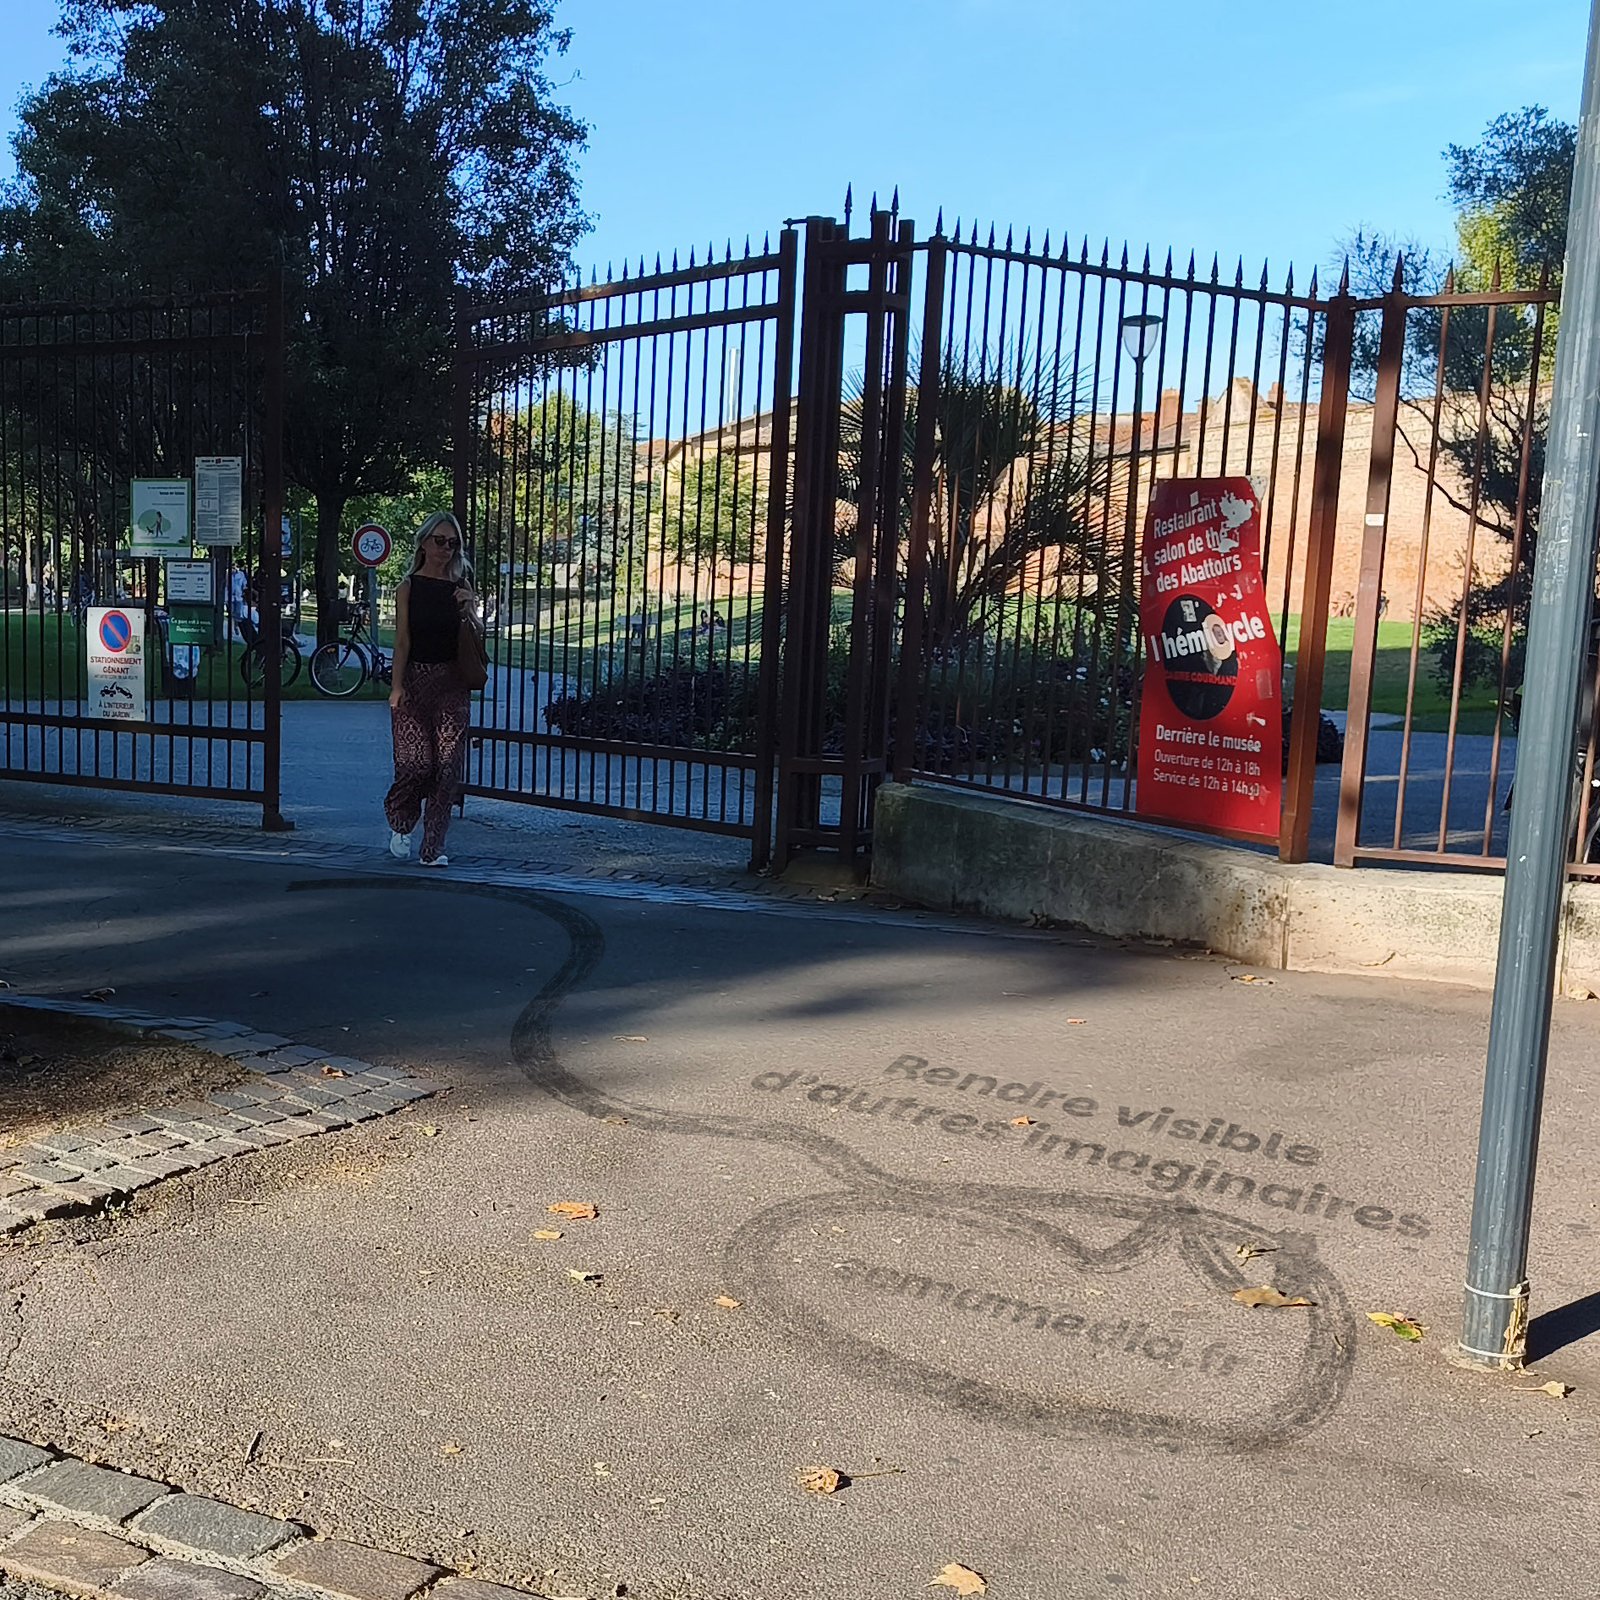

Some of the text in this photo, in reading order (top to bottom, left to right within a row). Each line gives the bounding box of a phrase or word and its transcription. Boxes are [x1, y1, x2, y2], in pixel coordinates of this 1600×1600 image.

[1153, 499, 1218, 539] Restaurant
[1154, 540, 1186, 566] salon
[1188, 533, 1204, 555] de
[1156, 554, 1242, 593] des Abattoirs
[90, 655, 142, 665] STATIONNEMENT
[1155, 724, 1262, 753] Derrière le musée
[1154, 749, 1261, 776] Ouverture de 12h à 18h
[1153, 768, 1187, 785] Service
[1188, 774, 1201, 787] de
[1203, 775, 1220, 790] 12h
[1221, 778, 1228, 792] à
[883, 1053, 1325, 1167] Rendre visible
[750, 1069, 1431, 1240] d'autres imaginaires
